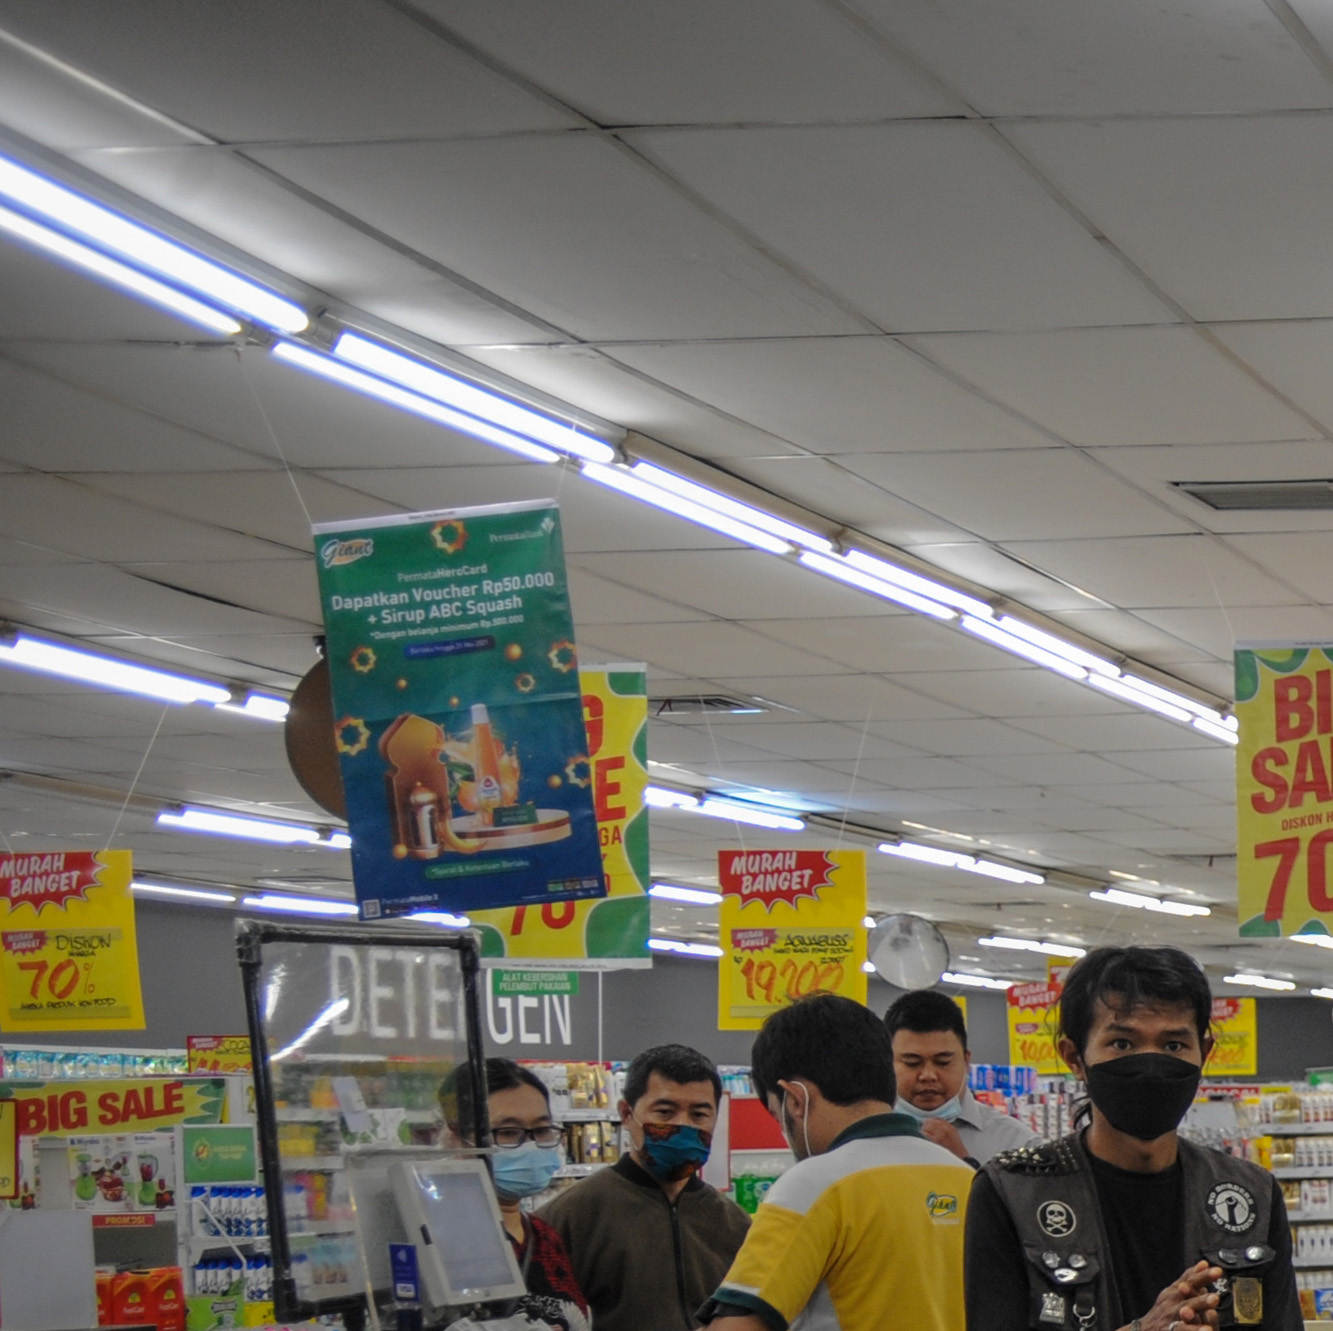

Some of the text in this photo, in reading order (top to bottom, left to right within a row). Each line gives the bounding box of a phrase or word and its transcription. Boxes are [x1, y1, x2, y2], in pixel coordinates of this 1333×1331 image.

[320, 538, 374, 569] Giant
[397, 564, 488, 583] PermataHeroCard
[331, 572, 555, 612] Dapatkan Voucher Rp50.000
[381, 607, 425, 624] Sirup
[429, 602, 462, 618] ABC
[467, 595, 523, 616] Squash
[1281, 812, 1324, 831] DISKON
[0, 854, 65, 876] MURAH
[730, 852, 797, 875] MURAH
[10, 871, 81, 897] BANGET
[741, 869, 813, 894] BANGET
[56, 933, 111, 951] DISKON
[17, 1081, 184, 1135] BIG SALE
